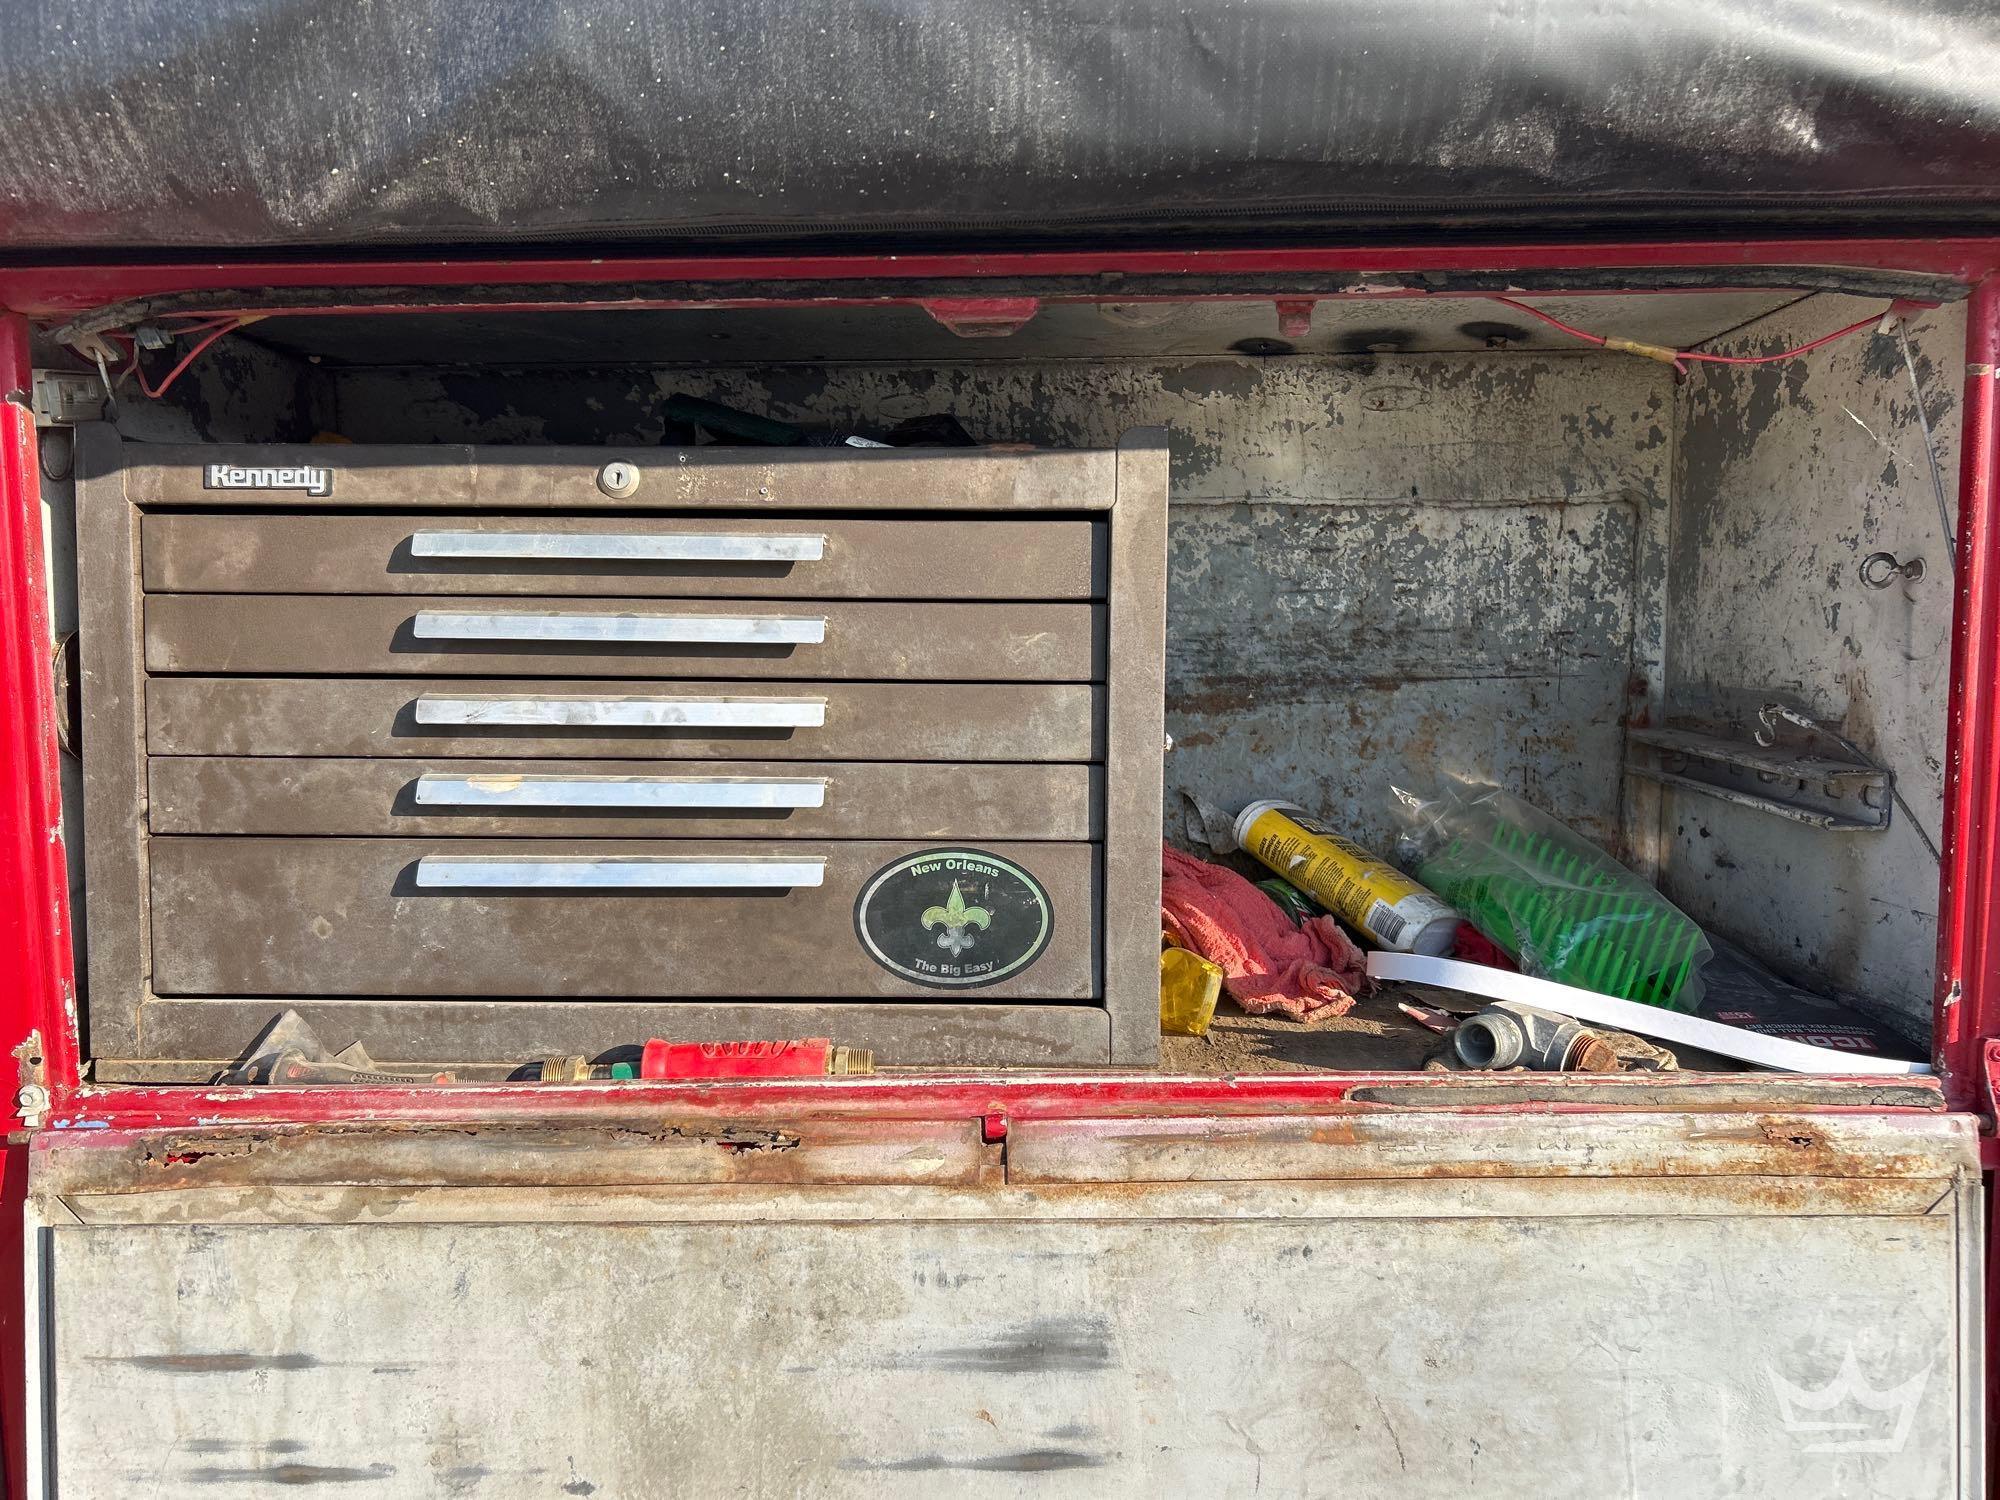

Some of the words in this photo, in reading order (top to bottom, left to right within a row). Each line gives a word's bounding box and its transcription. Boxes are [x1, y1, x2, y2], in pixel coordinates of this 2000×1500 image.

[211, 464, 325, 493] Kennedy
[911, 860, 942, 877] New
[945, 859, 1000, 877] Orleans
[915, 958, 937, 973] The
[940, 959, 961, 976] Big
[964, 959, 994, 974] Easy
